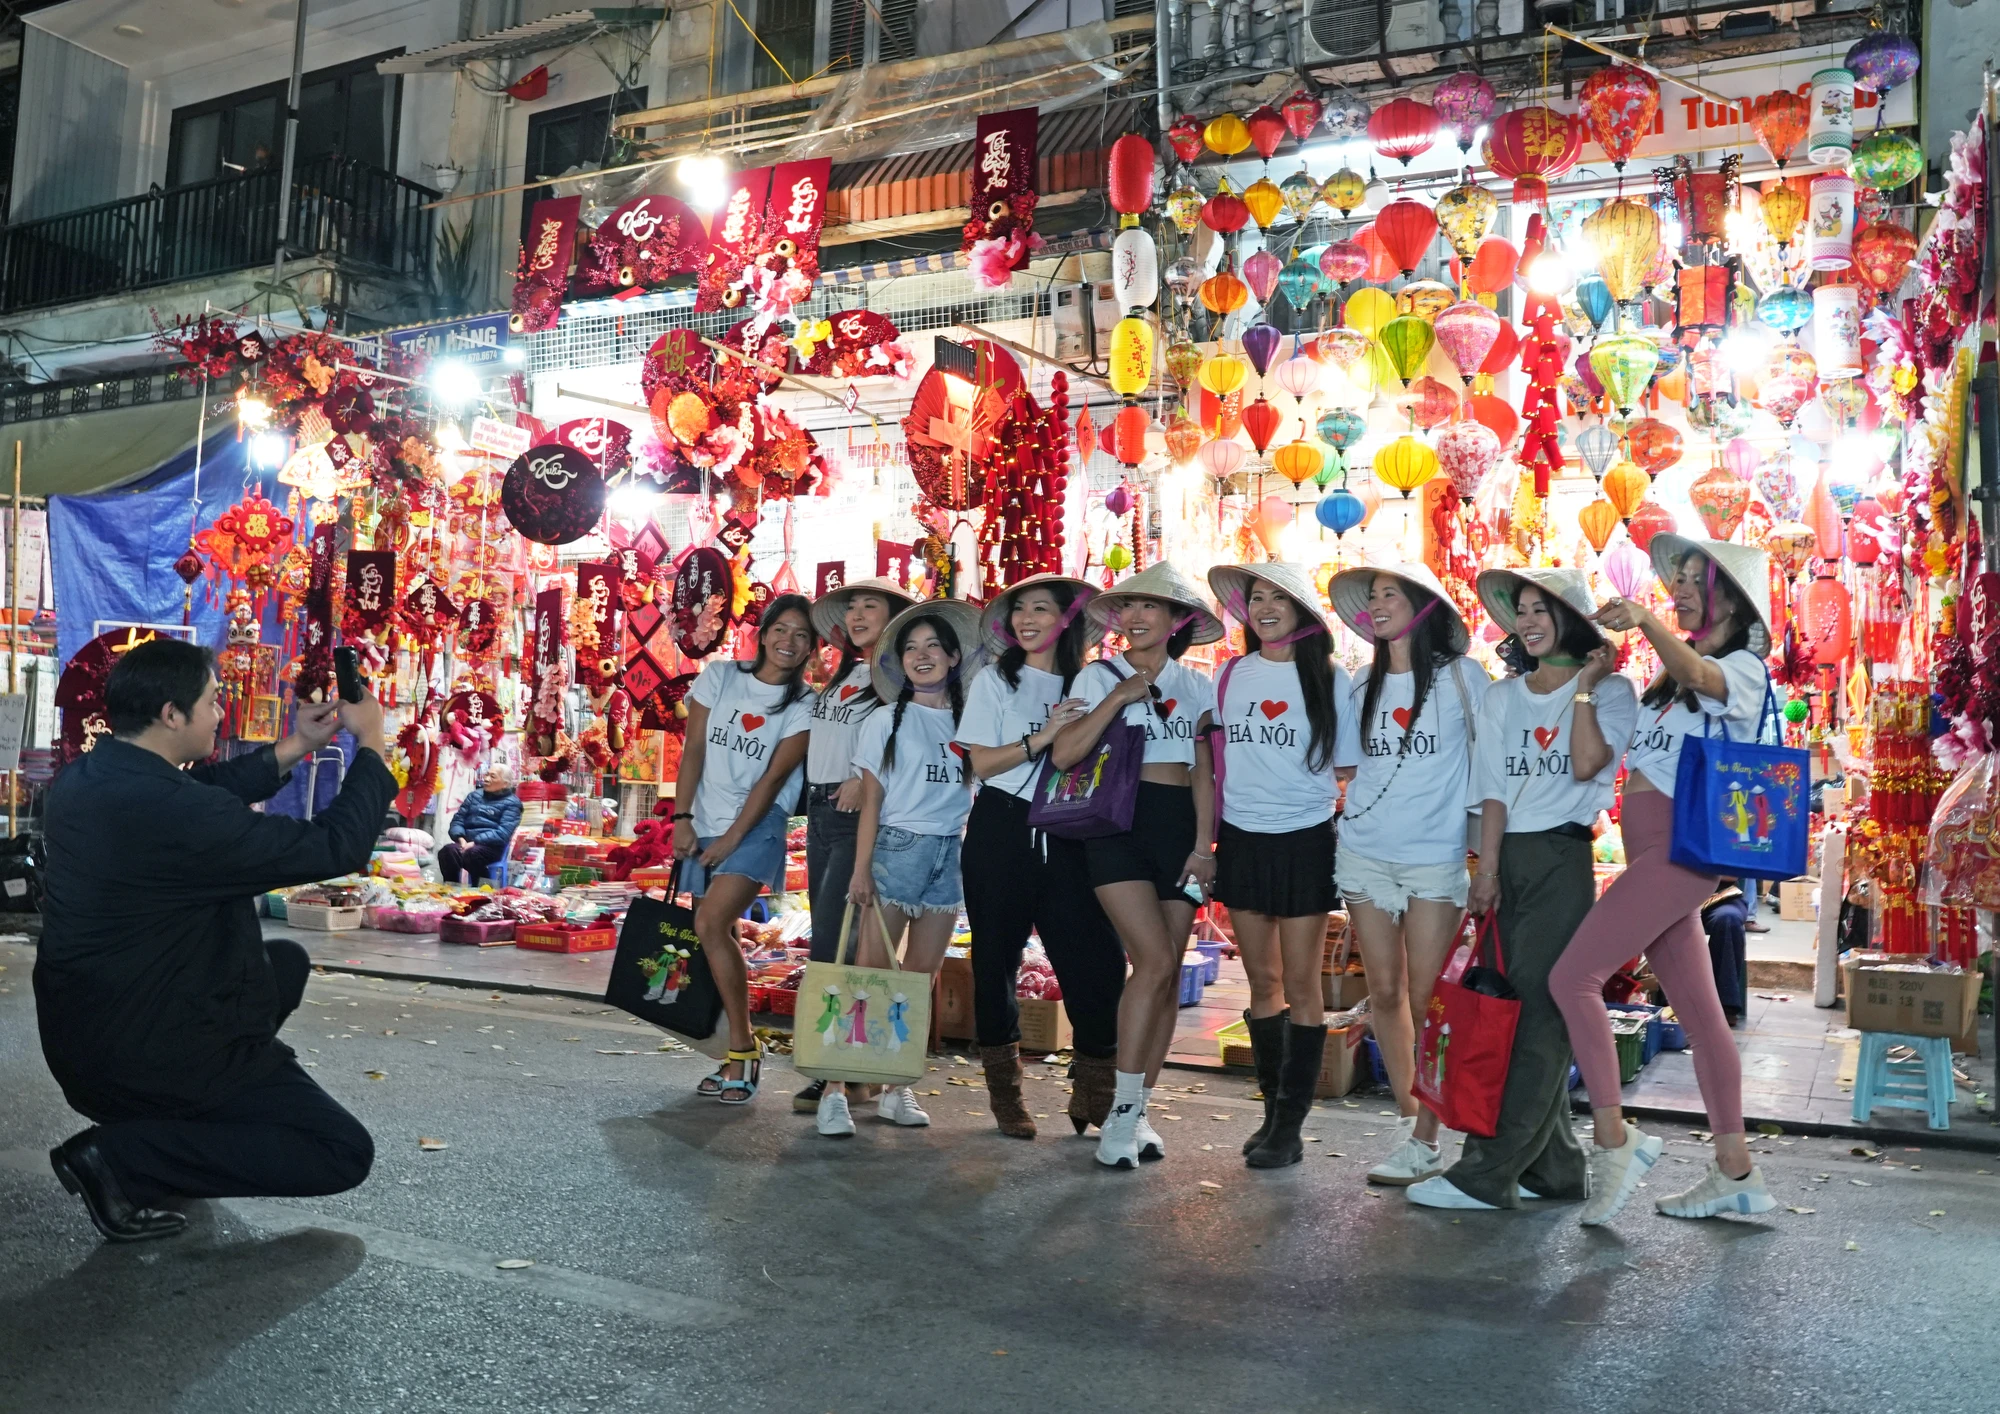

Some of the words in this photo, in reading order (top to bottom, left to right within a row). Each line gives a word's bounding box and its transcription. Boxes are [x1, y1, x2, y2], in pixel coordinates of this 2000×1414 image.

[1681, 94, 1770, 131] Tun
[829, 685, 840, 698] I
[728, 709, 741, 725] I
[1246, 702, 1256, 717] I
[1029, 720, 1049, 736] H
[1145, 719, 1157, 742] À
[1162, 716, 1194, 742] NỘI
[1380, 711, 1388, 729] I
[709, 726, 730, 747] HÀ
[732, 735, 767, 761] NỘI
[1229, 720, 1253, 744] HÀ
[1259, 722, 1296, 750] NỘI
[1368, 733, 1392, 757] HÀ
[1397, 730, 1436, 758] NỘI
[1521, 729, 1531, 748] I
[939, 743, 948, 758] I
[926, 761, 950, 783] HÀ
[1506, 752, 1531, 776] HÀ
[1536, 750, 1571, 777] NỘI
[1899, 980, 1925, 992] 220V
